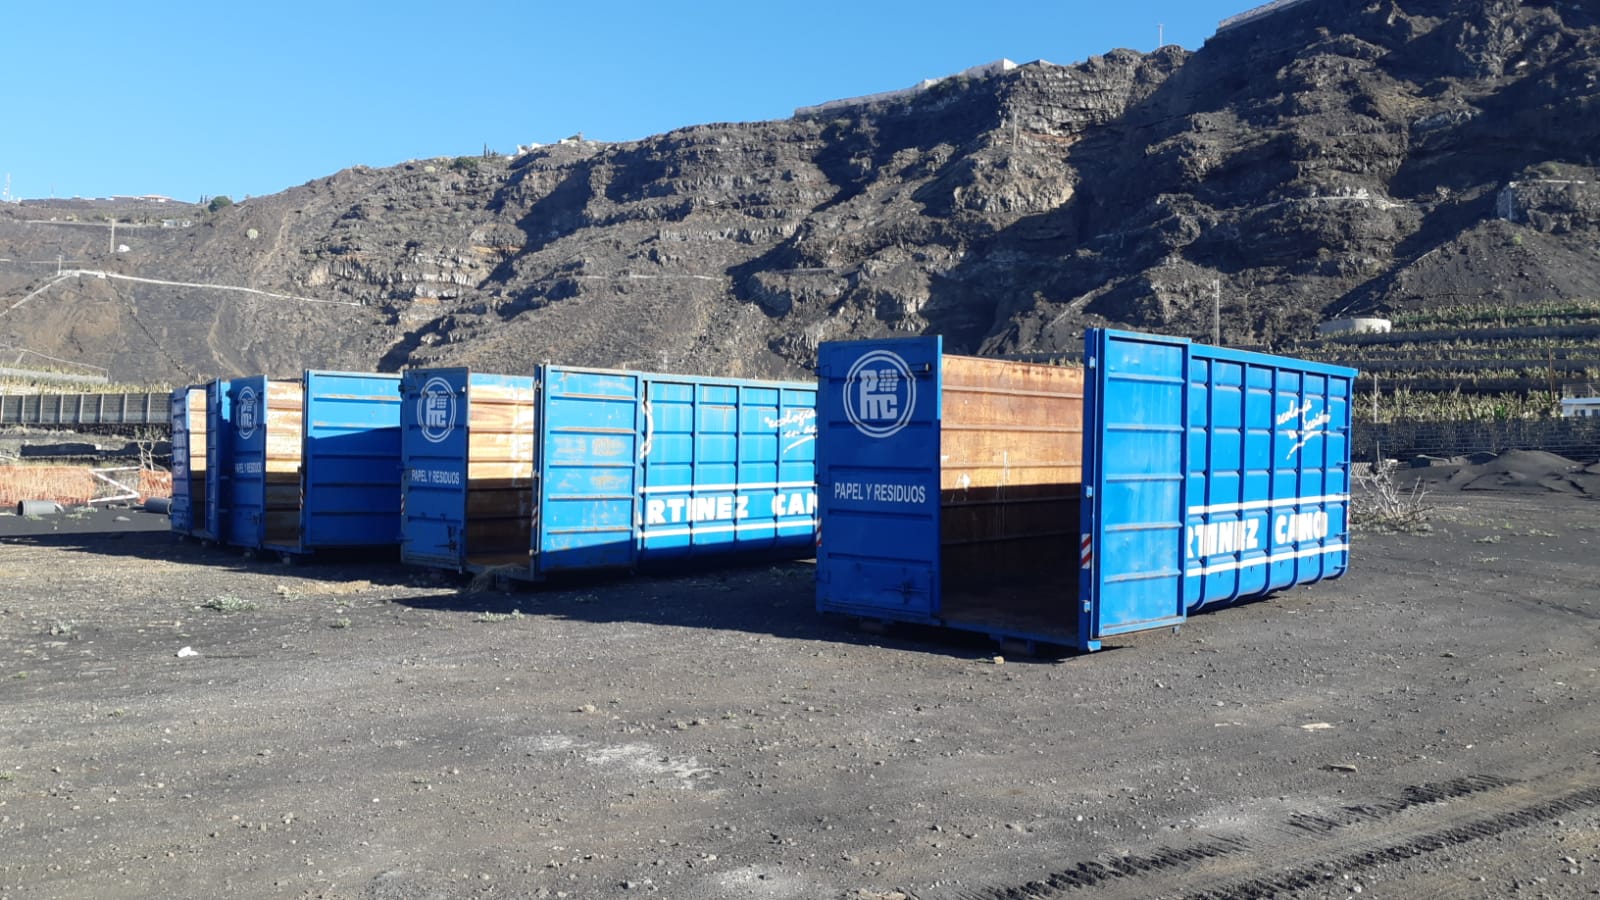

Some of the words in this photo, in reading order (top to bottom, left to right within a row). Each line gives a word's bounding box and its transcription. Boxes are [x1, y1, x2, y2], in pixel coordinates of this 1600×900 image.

[411, 469, 427, 482] PAPEL
[432, 470, 460, 485] RESIDUOS
[834, 482, 863, 500] PAPEL
[866, 484, 873, 500] Y
[874, 484, 926, 503] RESIDUOS
[638, 495, 749, 525] RTINEZ
[771, 492, 818, 516] CAN
[1187, 518, 1259, 558] RTINEZ
[1275, 511, 1328, 544] CANO
